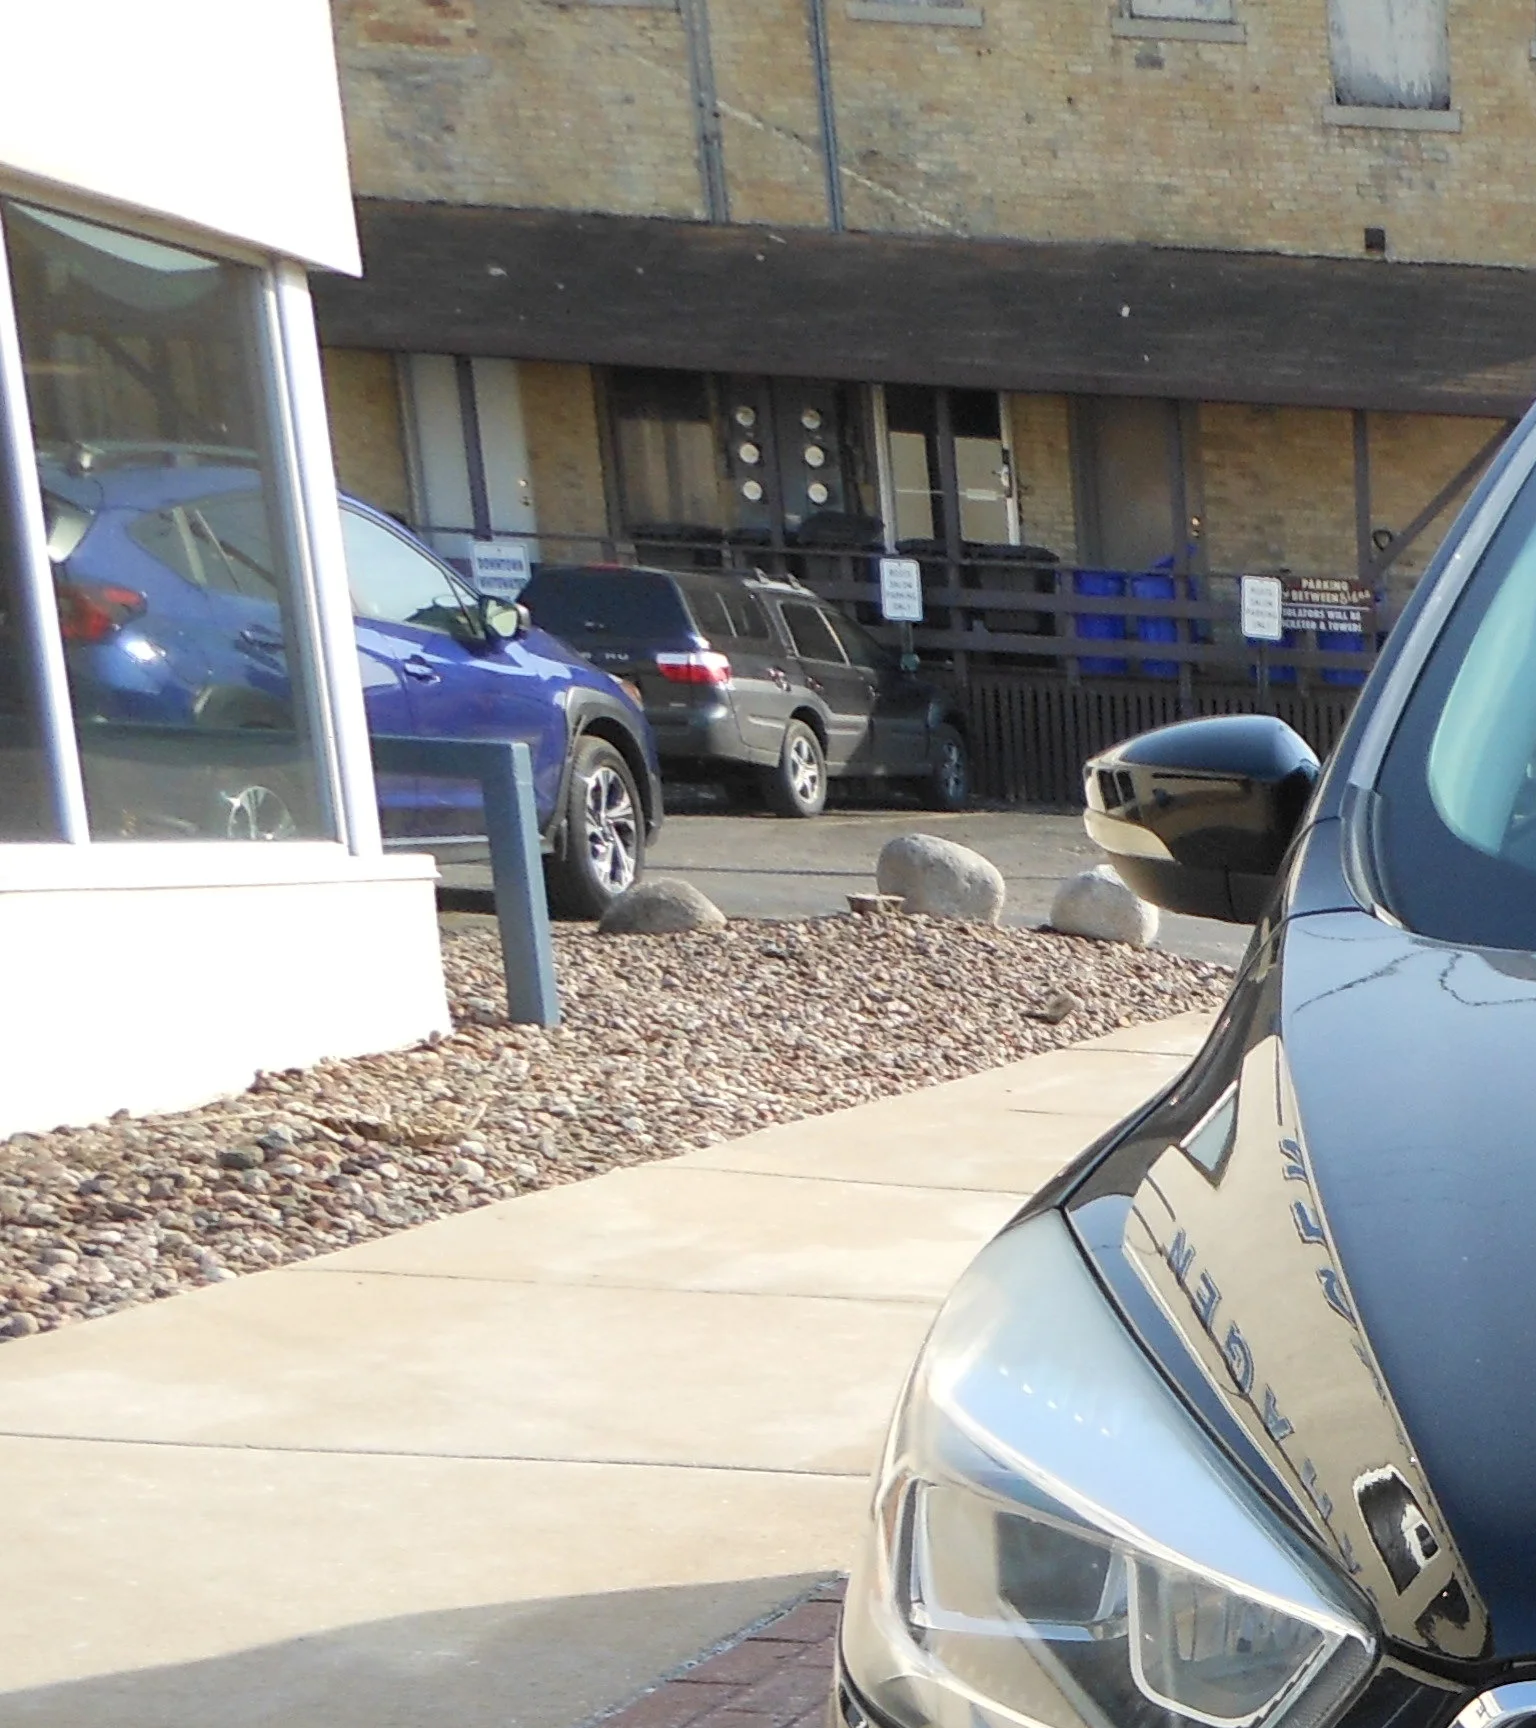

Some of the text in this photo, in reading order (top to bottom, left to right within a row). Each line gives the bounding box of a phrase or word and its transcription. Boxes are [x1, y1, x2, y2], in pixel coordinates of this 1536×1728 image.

[1301, 578, 1349, 591] PARKING
[1291, 588, 1339, 603] BETWEEN
[1327, 610, 1348, 620] WILL
